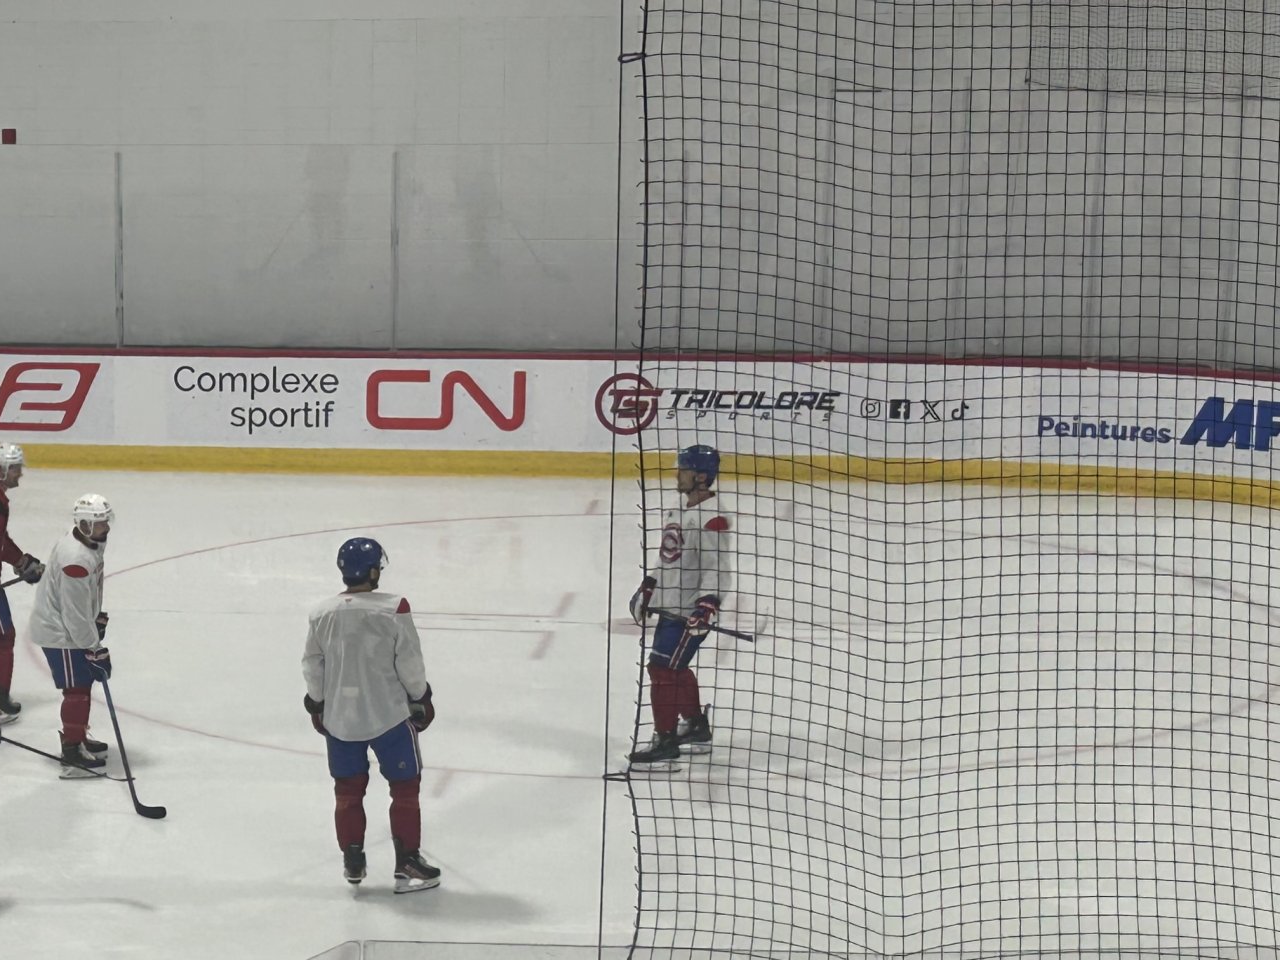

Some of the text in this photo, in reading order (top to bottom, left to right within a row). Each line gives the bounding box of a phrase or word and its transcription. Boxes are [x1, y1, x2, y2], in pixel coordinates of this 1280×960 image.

[174, 366, 339, 400] Complexe
[669, 388, 841, 411] TRICOLORE
[366, 369, 526, 432] CN
[230, 401, 335, 434] sportif
[1037, 415, 1172, 444] Peintures
